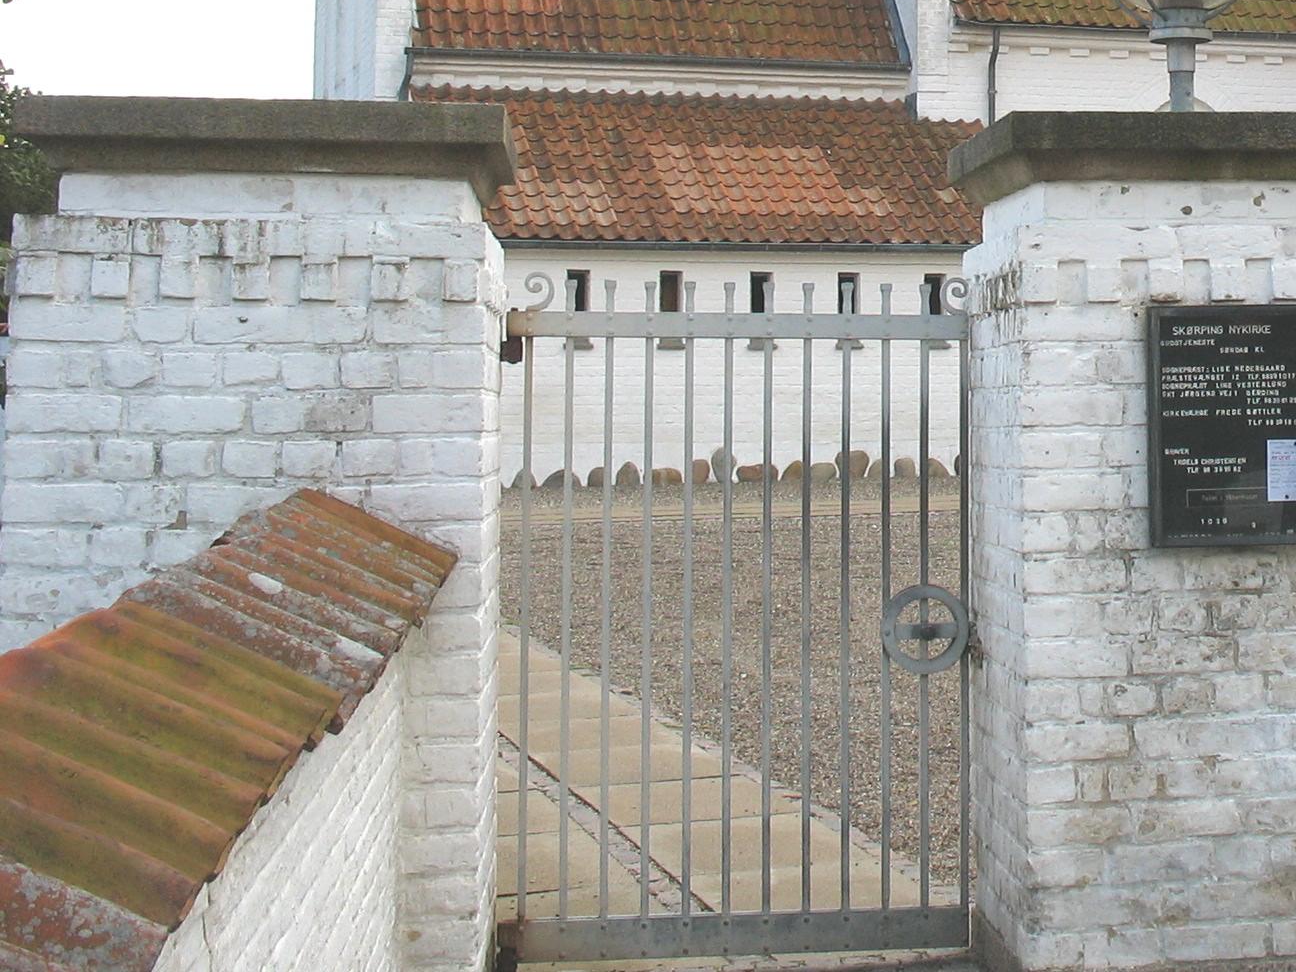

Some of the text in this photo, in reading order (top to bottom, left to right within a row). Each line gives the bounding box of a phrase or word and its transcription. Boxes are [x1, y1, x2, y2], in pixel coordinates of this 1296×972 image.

[1172, 324, 1272, 336] SKØRPING NYKIRKE
[1234, 364, 1286, 372] NEDERGAARD
